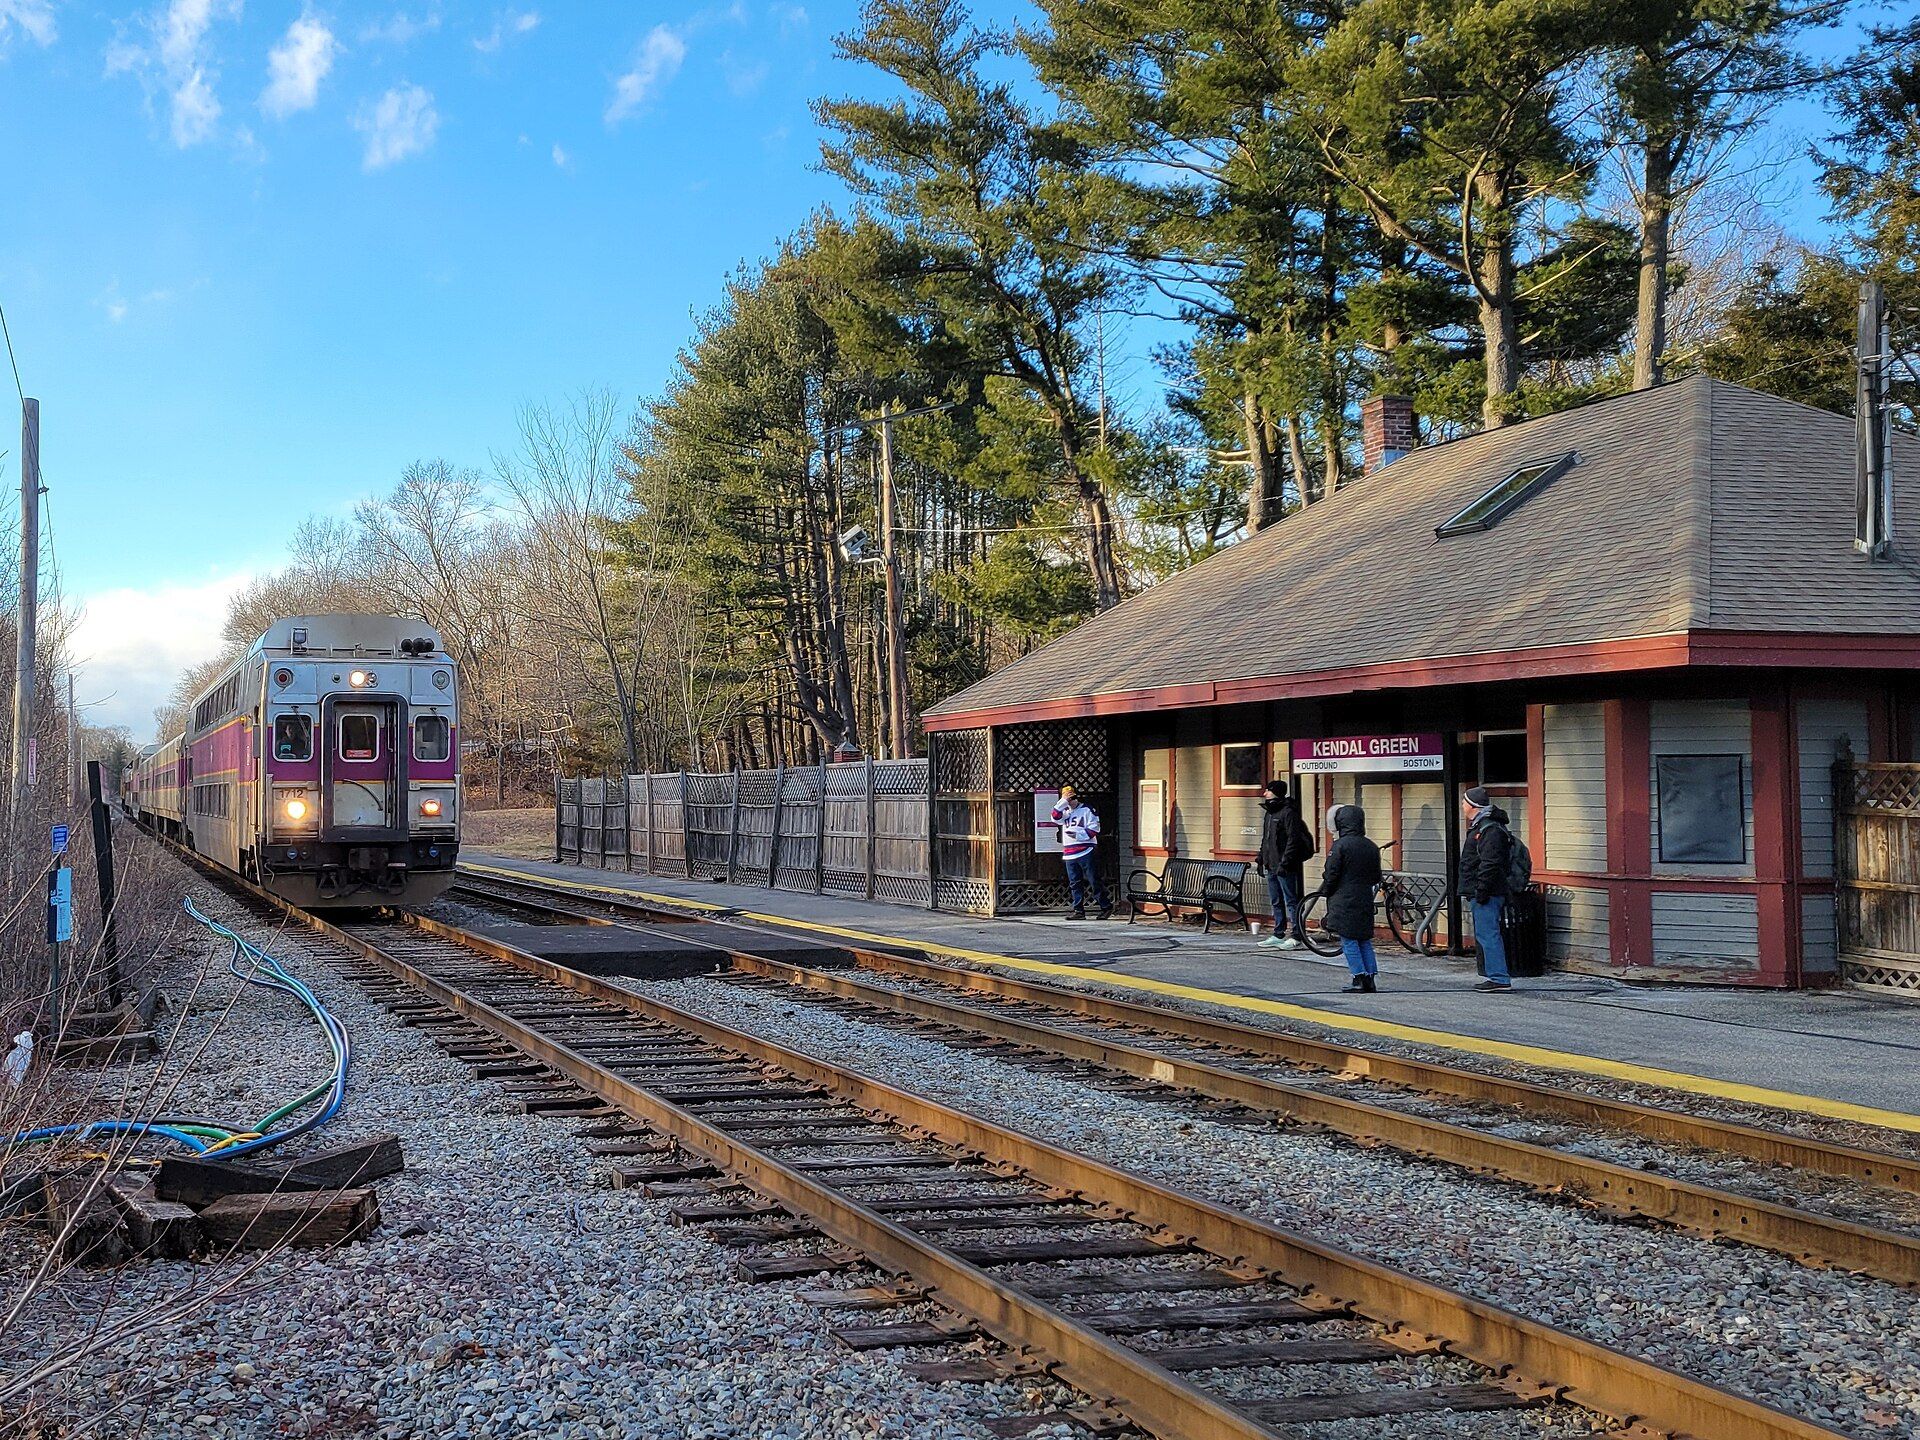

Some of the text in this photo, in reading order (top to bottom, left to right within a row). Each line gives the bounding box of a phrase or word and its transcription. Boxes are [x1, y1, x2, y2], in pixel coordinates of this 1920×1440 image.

[1313, 737, 1419, 757] KENDAL GREEN
[1301, 761, 1338, 770] OUTBOUND
[1403, 758, 1435, 768] BOSTON
[279, 789, 304, 799] 1712
[1064, 816, 1085, 828] USA
